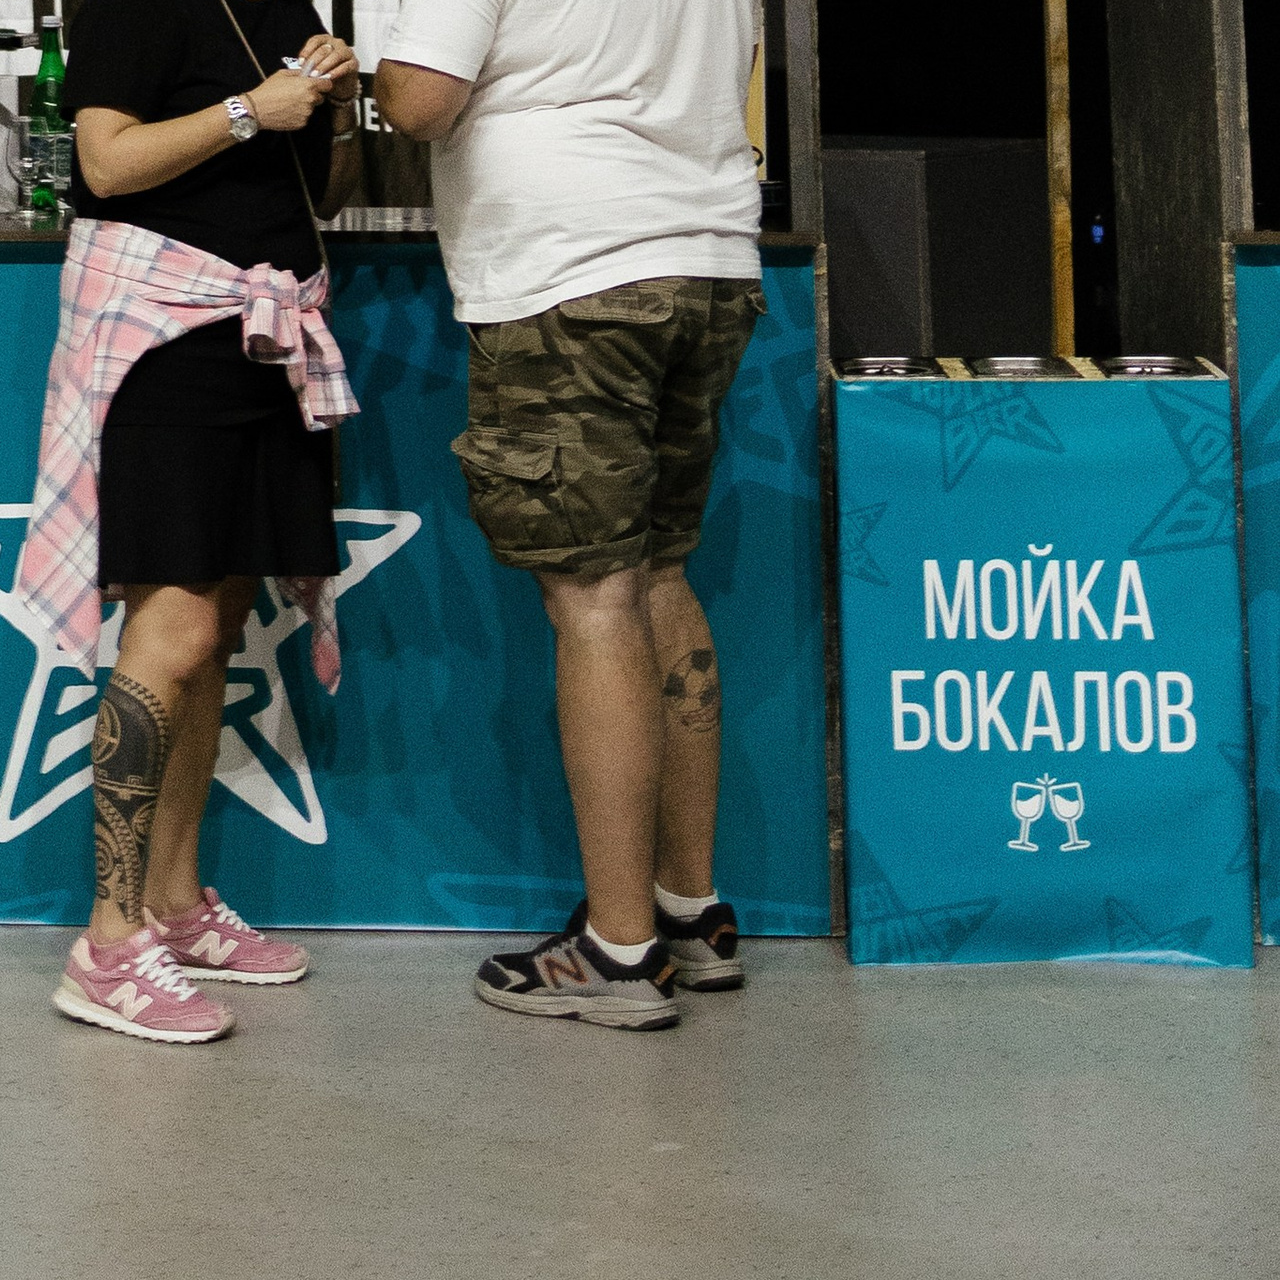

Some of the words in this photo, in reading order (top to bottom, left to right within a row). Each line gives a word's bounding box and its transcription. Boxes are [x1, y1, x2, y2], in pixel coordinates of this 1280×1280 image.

[923, 543, 1156, 641] МОЙКА
[890, 669, 1198, 753] БОКАЛОВ
[188, 930, 240, 966] N
[106, 980, 154, 1021] N
